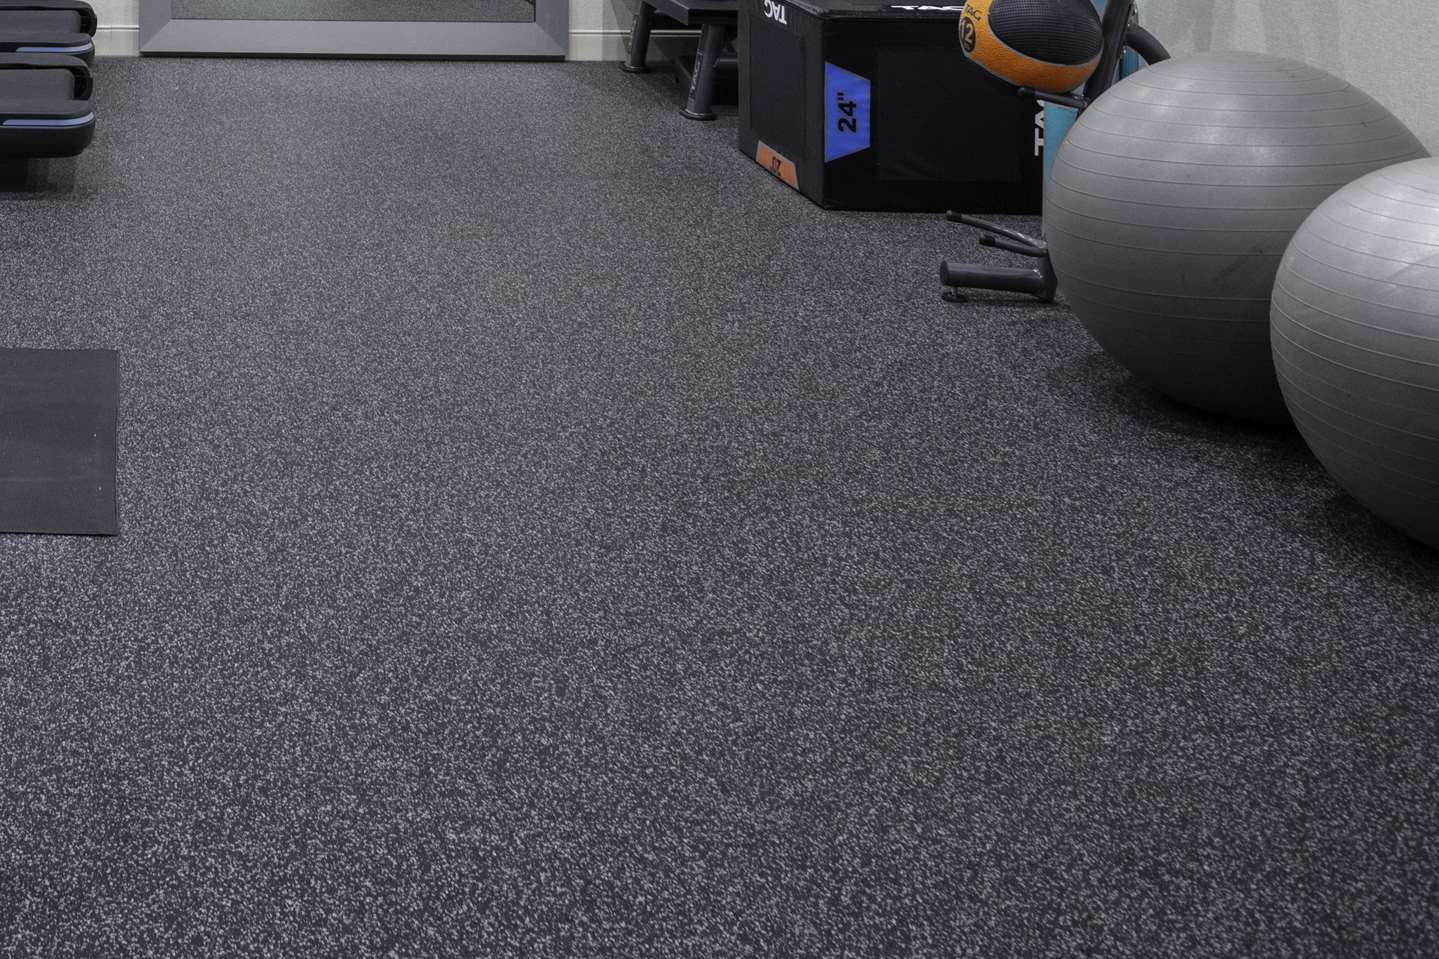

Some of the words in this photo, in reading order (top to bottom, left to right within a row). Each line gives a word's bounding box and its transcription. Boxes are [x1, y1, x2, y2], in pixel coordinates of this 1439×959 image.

[965, 3, 983, 21] TAG
[960, 19, 973, 44] 12
[836, 91, 857, 134] 24"
